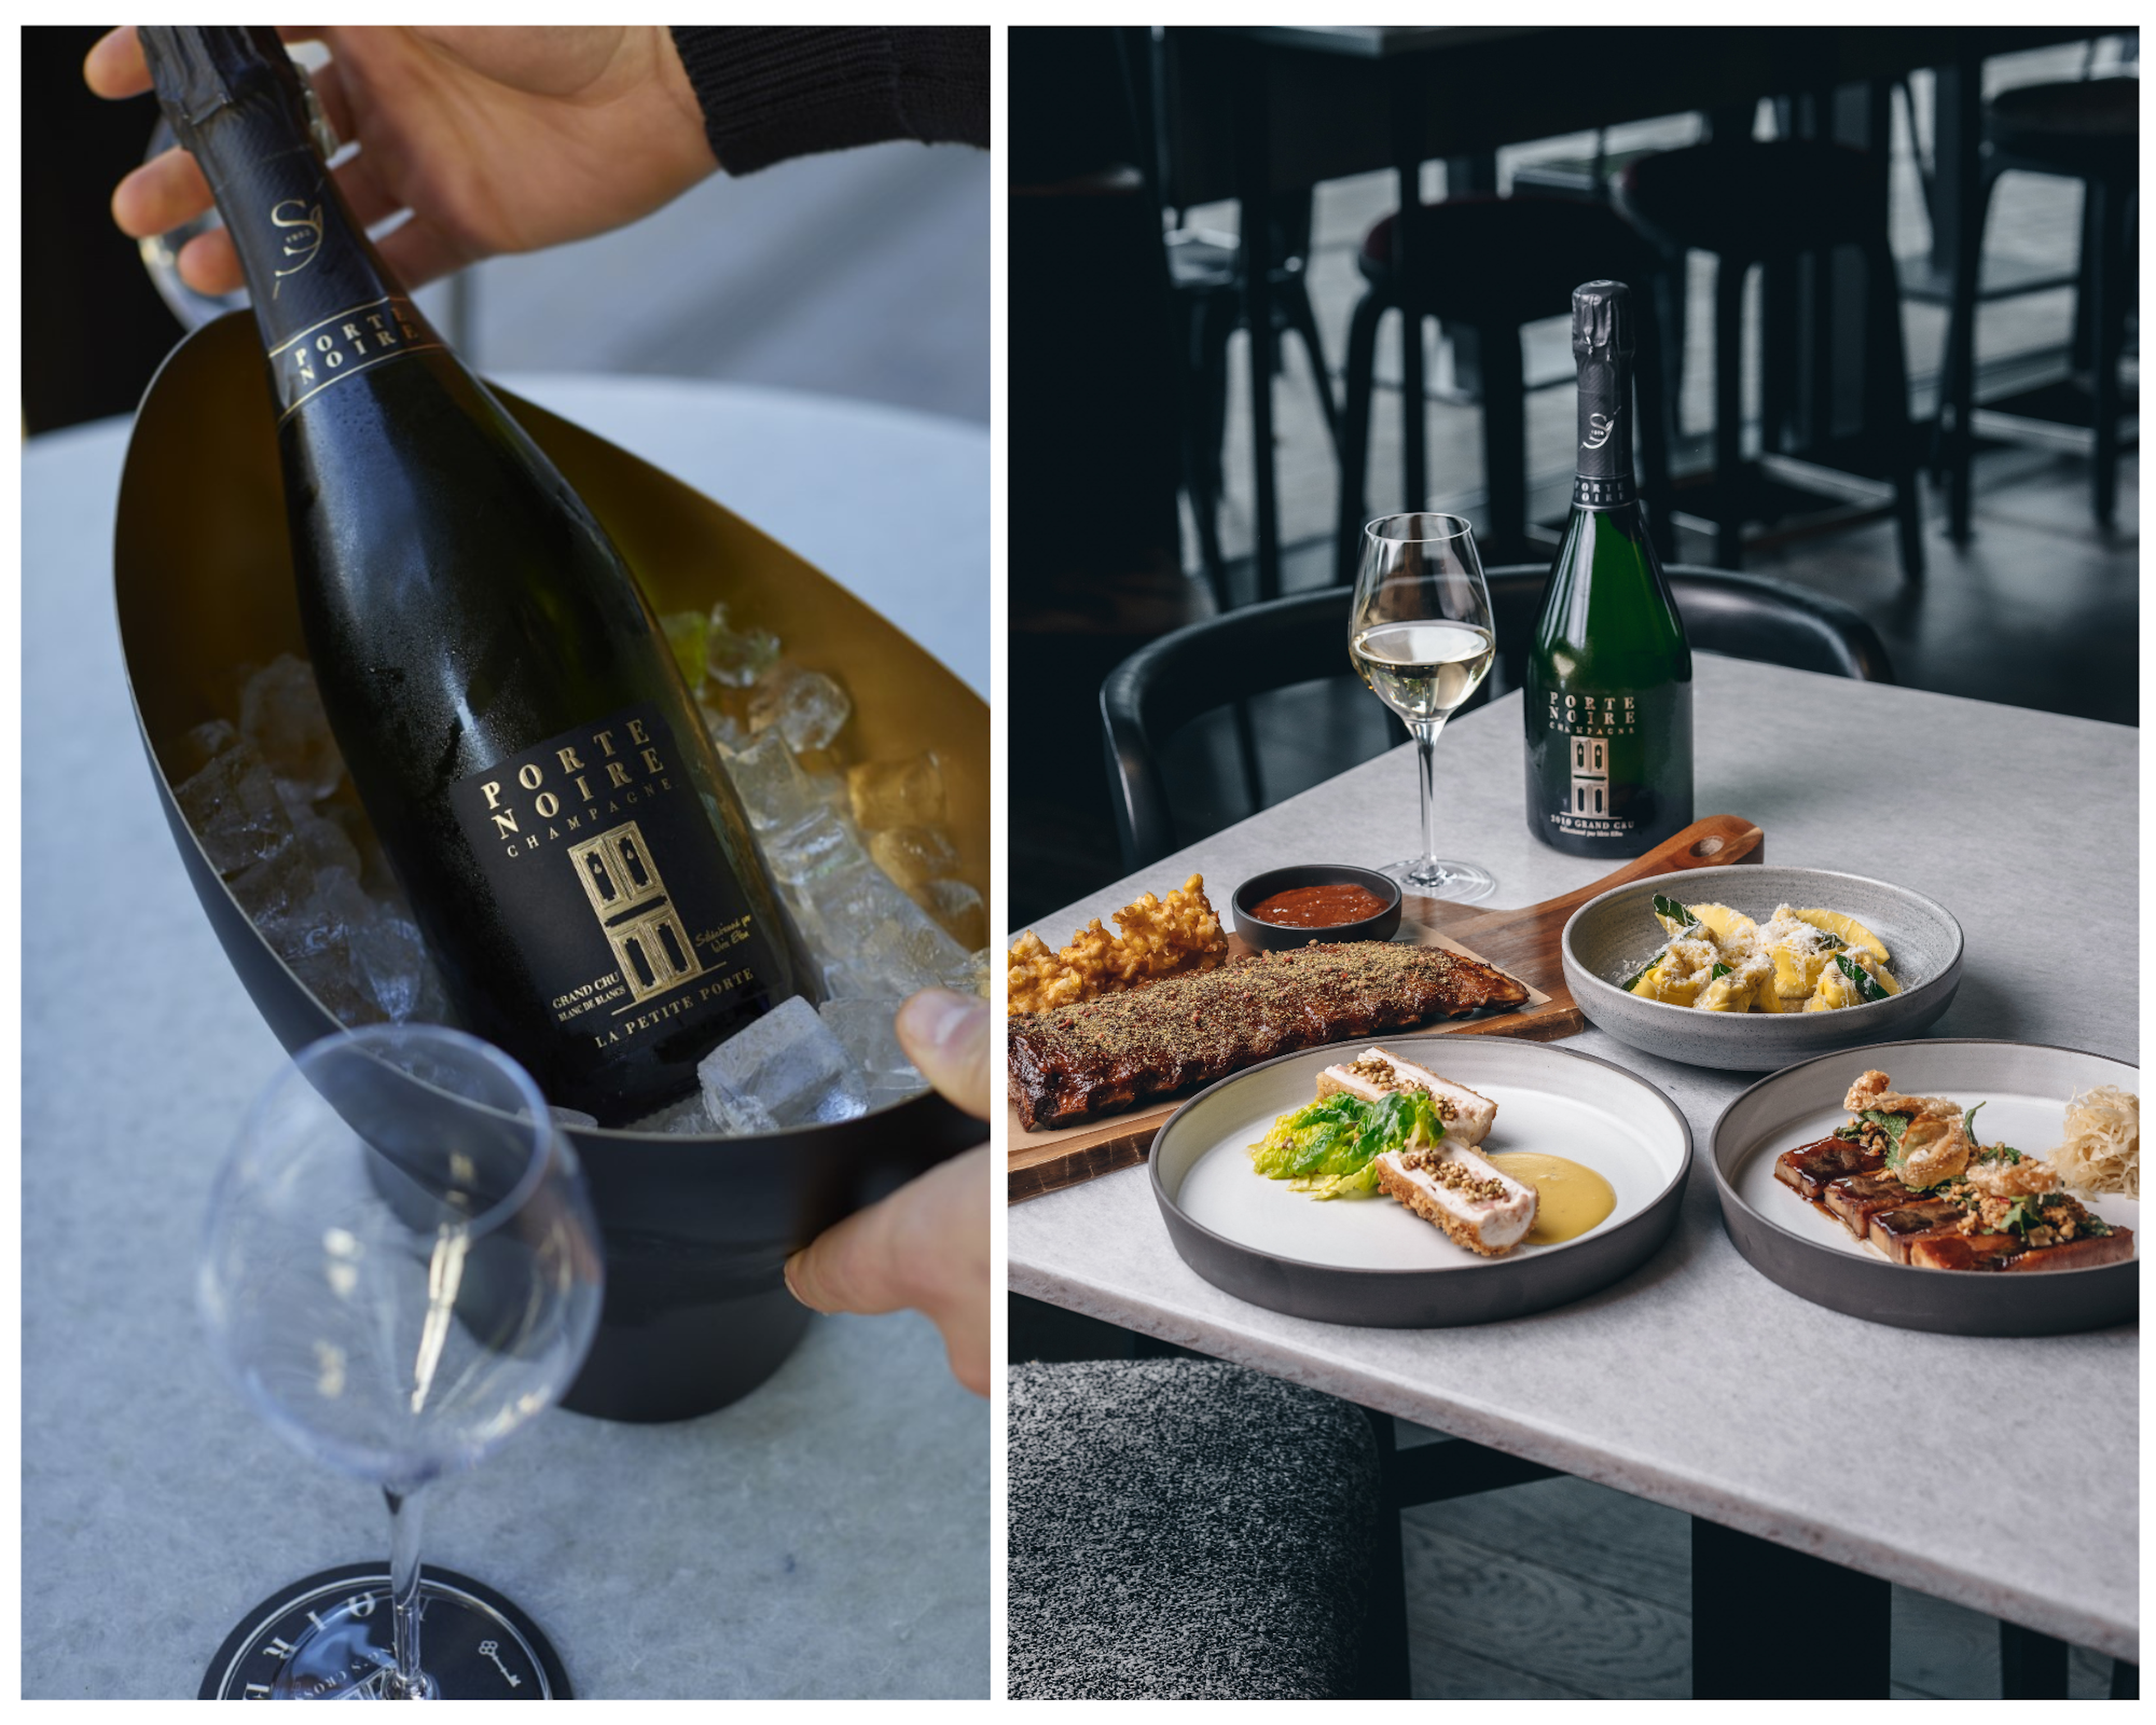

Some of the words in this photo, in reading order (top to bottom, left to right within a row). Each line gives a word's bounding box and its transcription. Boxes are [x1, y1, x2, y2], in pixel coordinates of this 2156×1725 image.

[294, 307, 408, 366] PORTE
[299, 323, 418, 385] NOIRE
[1549, 706, 1635, 725] NOIRE
[1550, 691, 1635, 710] PORTE
[1549, 722, 1635, 735] CHAMPAGNE
[481, 719, 650, 809] PORTE
[492, 747, 665, 839] NOIRE
[507, 778, 672, 857] CHAMPAGNE
[1574, 819, 1610, 829] GRAND
[1613, 821, 1634, 829] CRU
[552, 984, 592, 1008] GRAND
[595, 971, 619, 990] CRU
[558, 1005, 583, 1021] BLANC
[583, 1000, 595, 1011] DE
[595, 985, 625, 1005] BLANCS
[595, 1031, 619, 1048] LA
[625, 996, 693, 1034] PETITE
[698, 968, 754, 1001] PORTE
